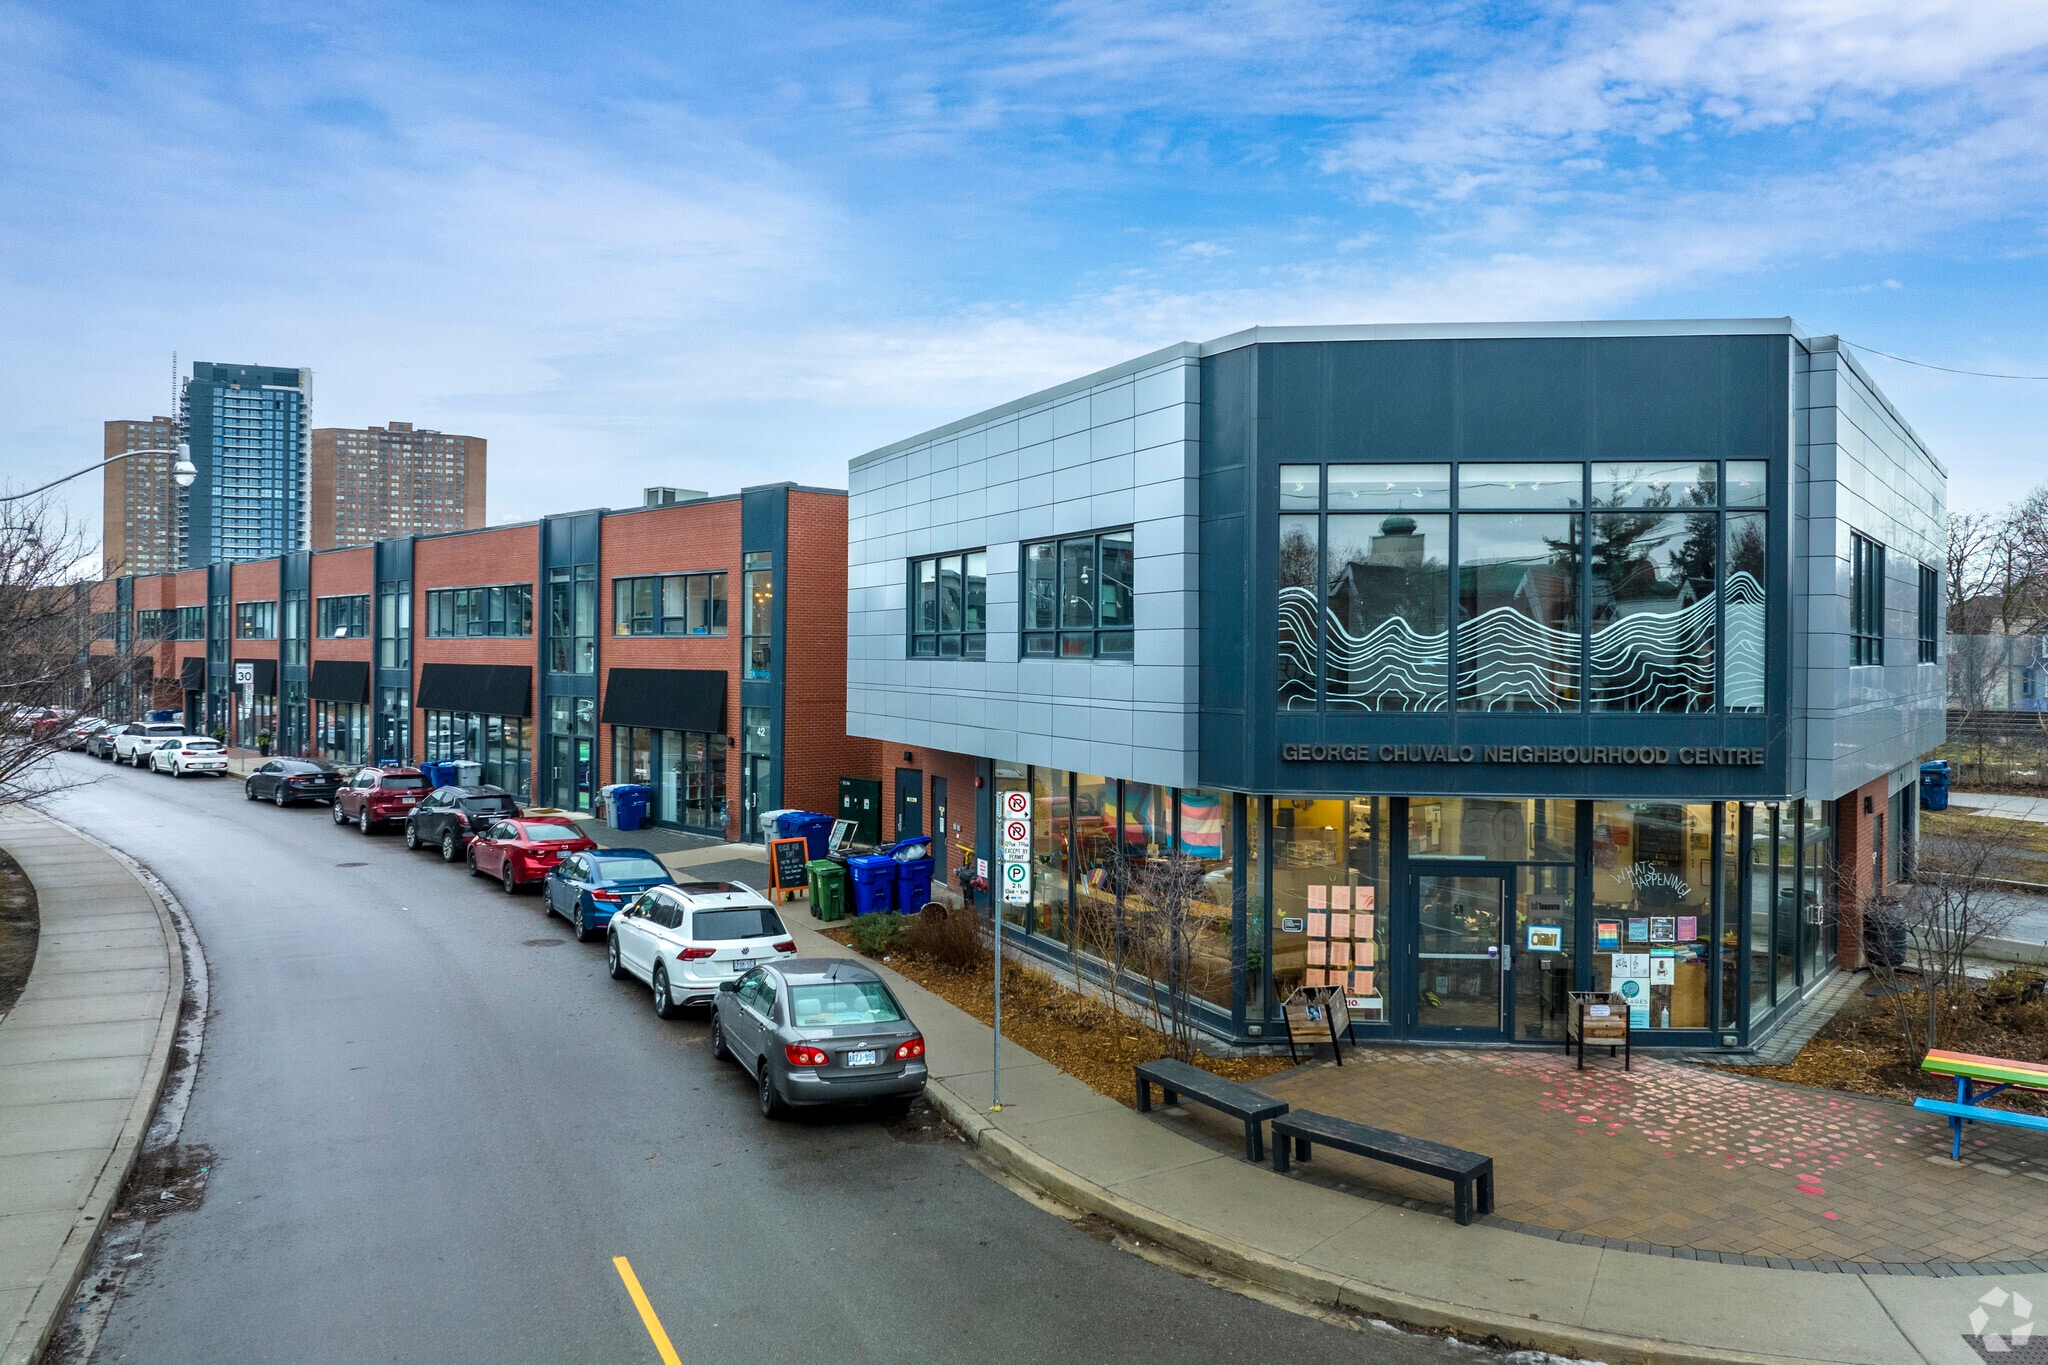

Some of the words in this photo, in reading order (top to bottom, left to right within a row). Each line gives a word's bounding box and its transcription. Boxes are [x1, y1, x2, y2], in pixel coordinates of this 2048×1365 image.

[238, 672, 251, 681] 30
[757, 727, 766, 736] 42
[1282, 744, 1369, 761] GEORGE
[1378, 745, 1475, 763] CHUVALO
[1484, 746, 1670, 764] NEIGHBOURHOOD
[1679, 747, 1765, 765] CENTRE
[1609, 860, 1656, 885] WHAT'S
[1630, 872, 1692, 898] HAPPENING!
